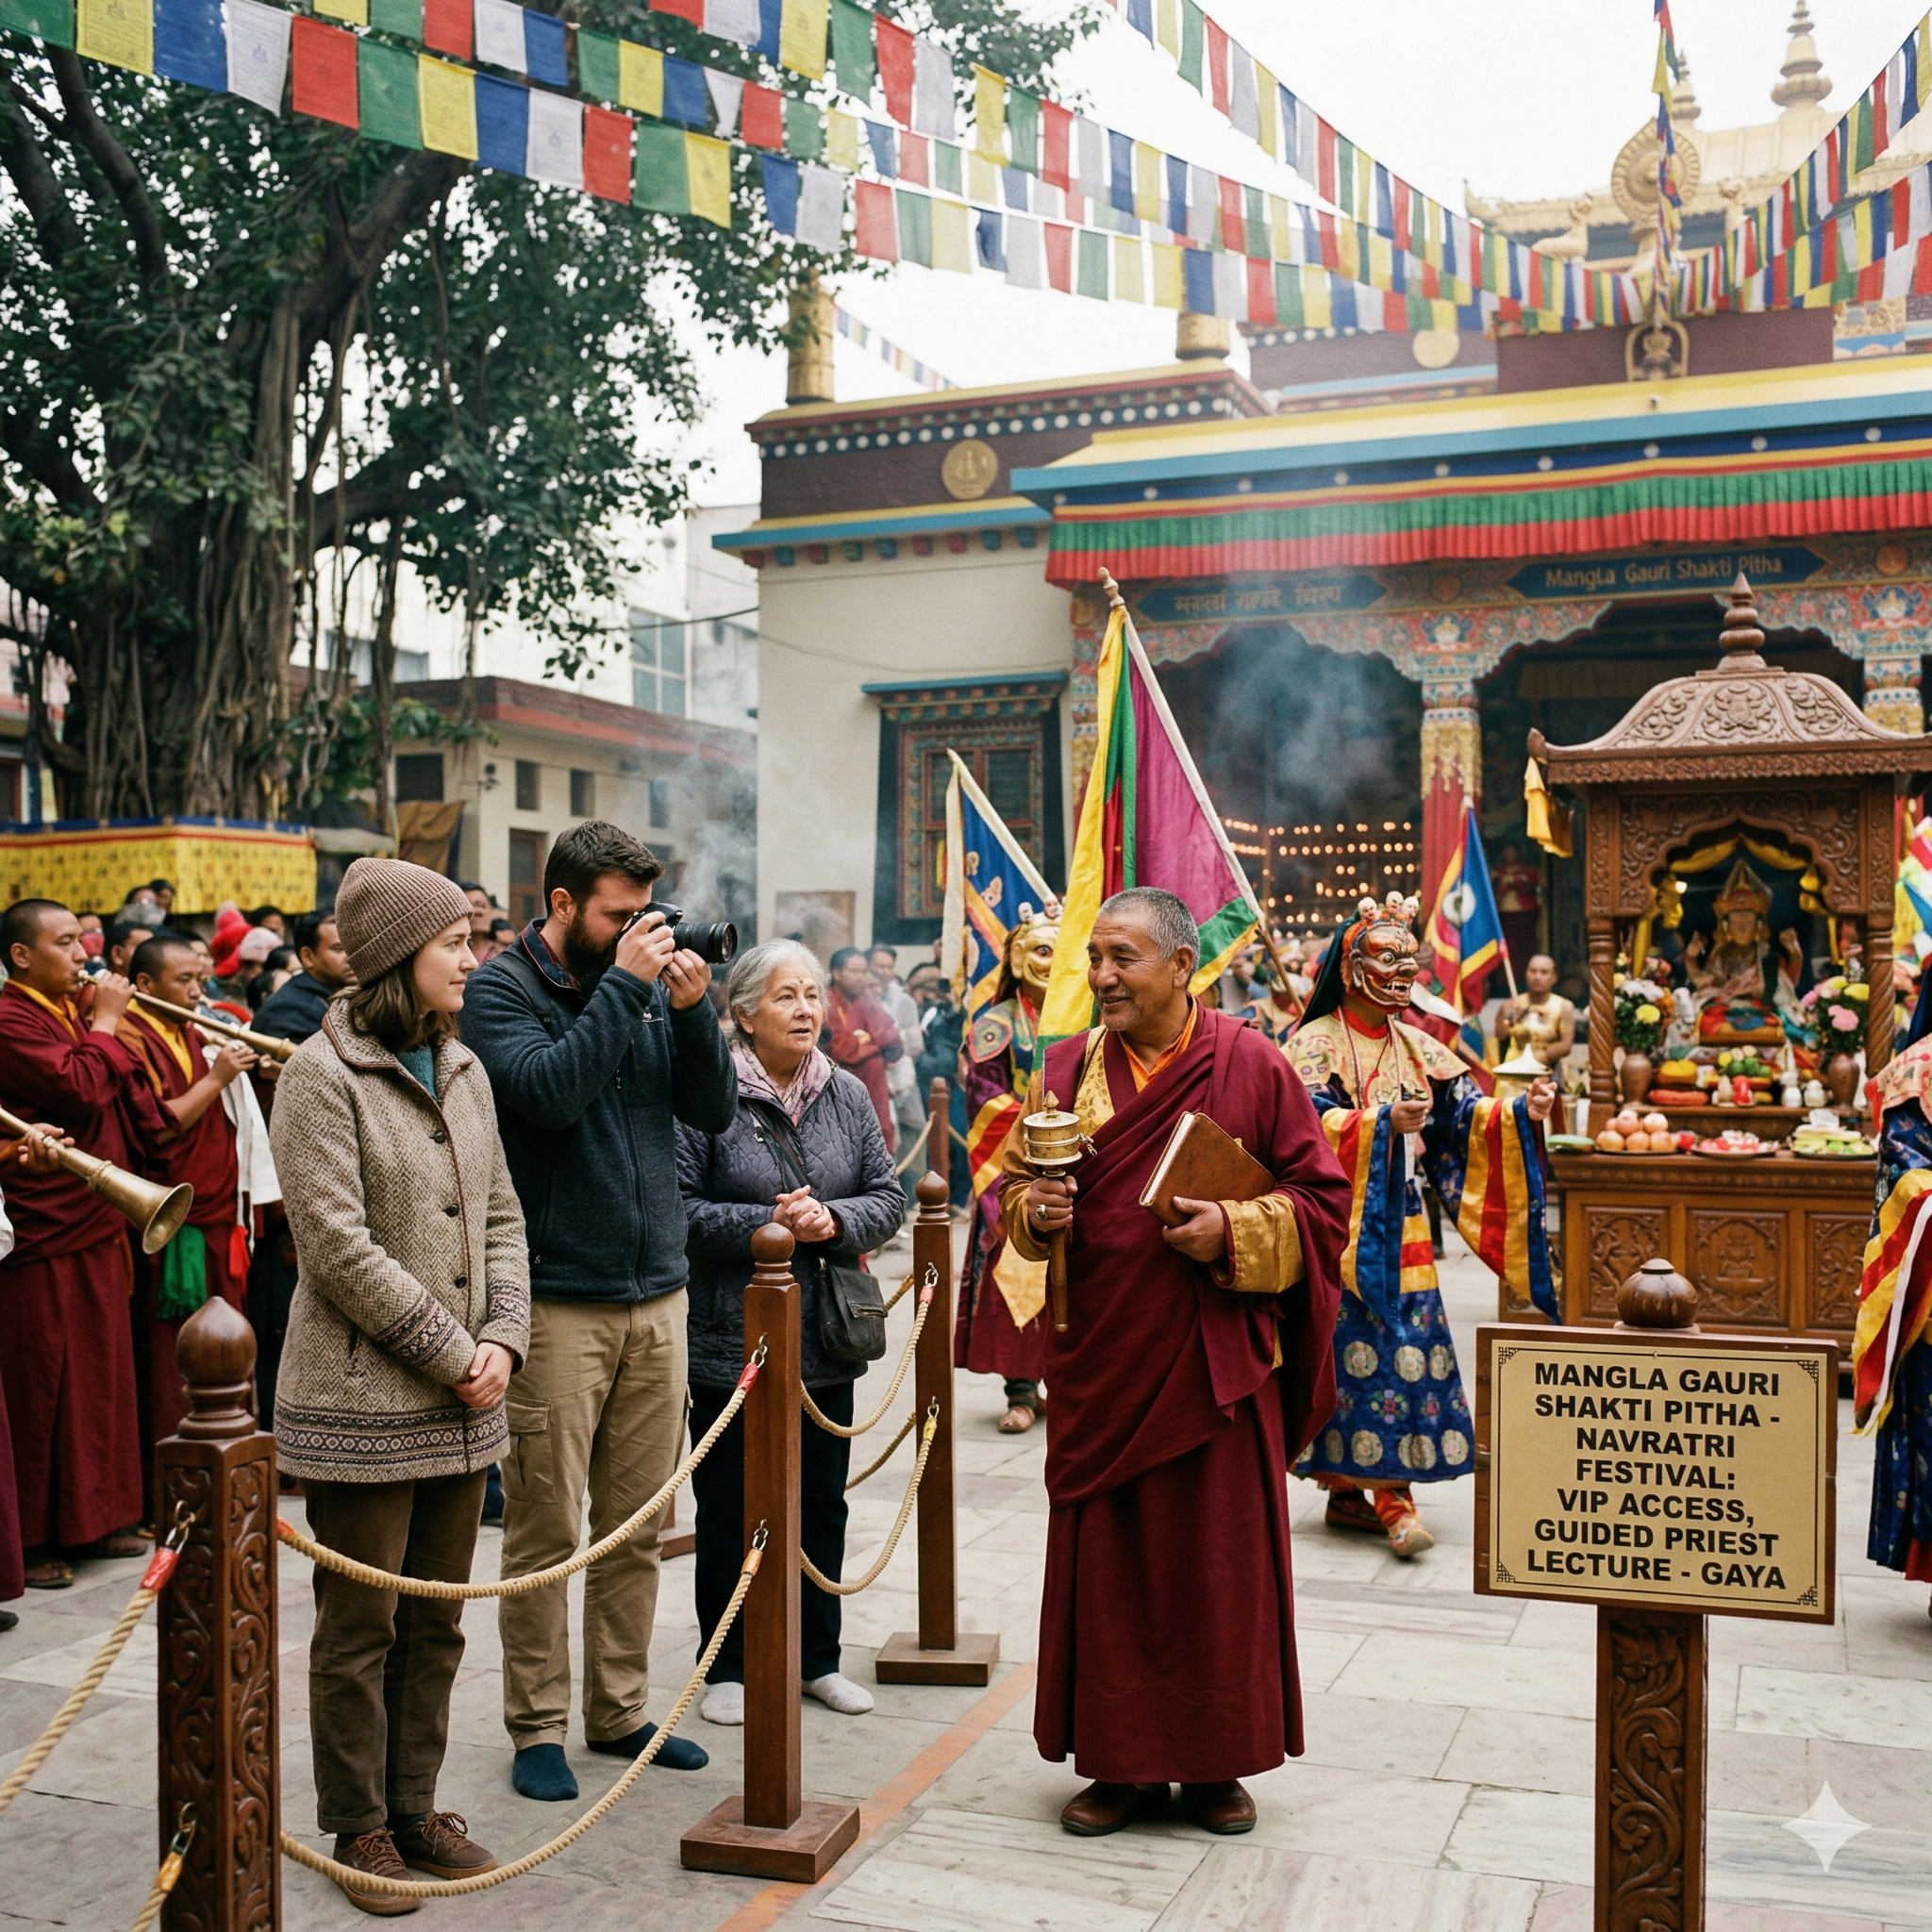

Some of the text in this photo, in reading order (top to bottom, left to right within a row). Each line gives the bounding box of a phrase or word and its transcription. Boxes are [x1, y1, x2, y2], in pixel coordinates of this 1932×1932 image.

[1624, 559, 1671, 583] Gauri
[1675, 556, 1732, 580] Shakti
[1535, 1362, 1779, 1397] MANGLA GAURI
[1535, 1393, 1652, 1422] SHAKTI
[1664, 1400, 1761, 1428] PITHA
[1576, 1427, 1735, 1458] NAVRATRI
[1576, 1458, 1735, 1491] FESTIVAL:
[1557, 1488, 1755, 1529] VIP ACCESS,
[1534, 1518, 1779, 1557] GUIDED PRIEST
[1527, 1549, 1672, 1582] LECTURE
[1701, 1561, 1786, 1591] GAYA
